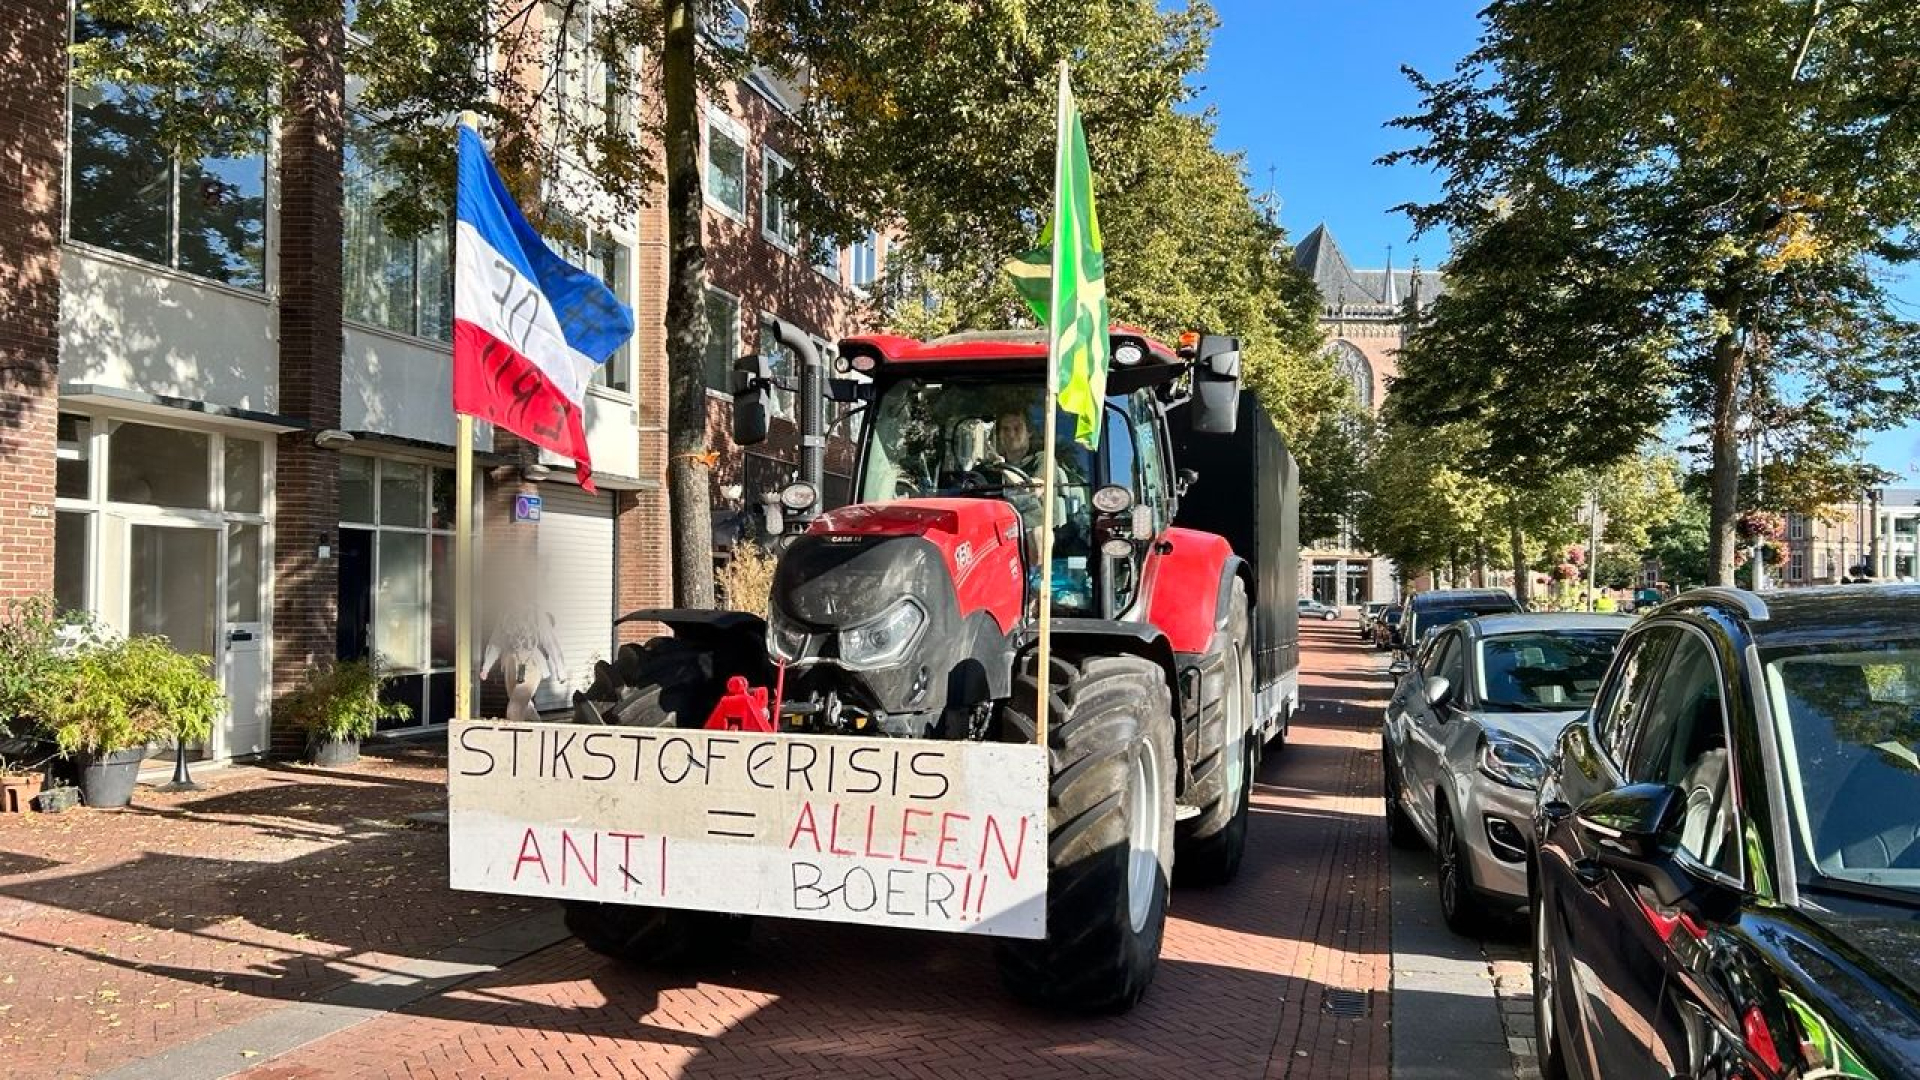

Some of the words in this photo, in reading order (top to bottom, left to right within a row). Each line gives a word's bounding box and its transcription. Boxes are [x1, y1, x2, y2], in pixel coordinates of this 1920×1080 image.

[512, 827, 667, 896] ANTI
[791, 861, 988, 922] BOER!!
[788, 801, 1027, 880] ALLEEN
